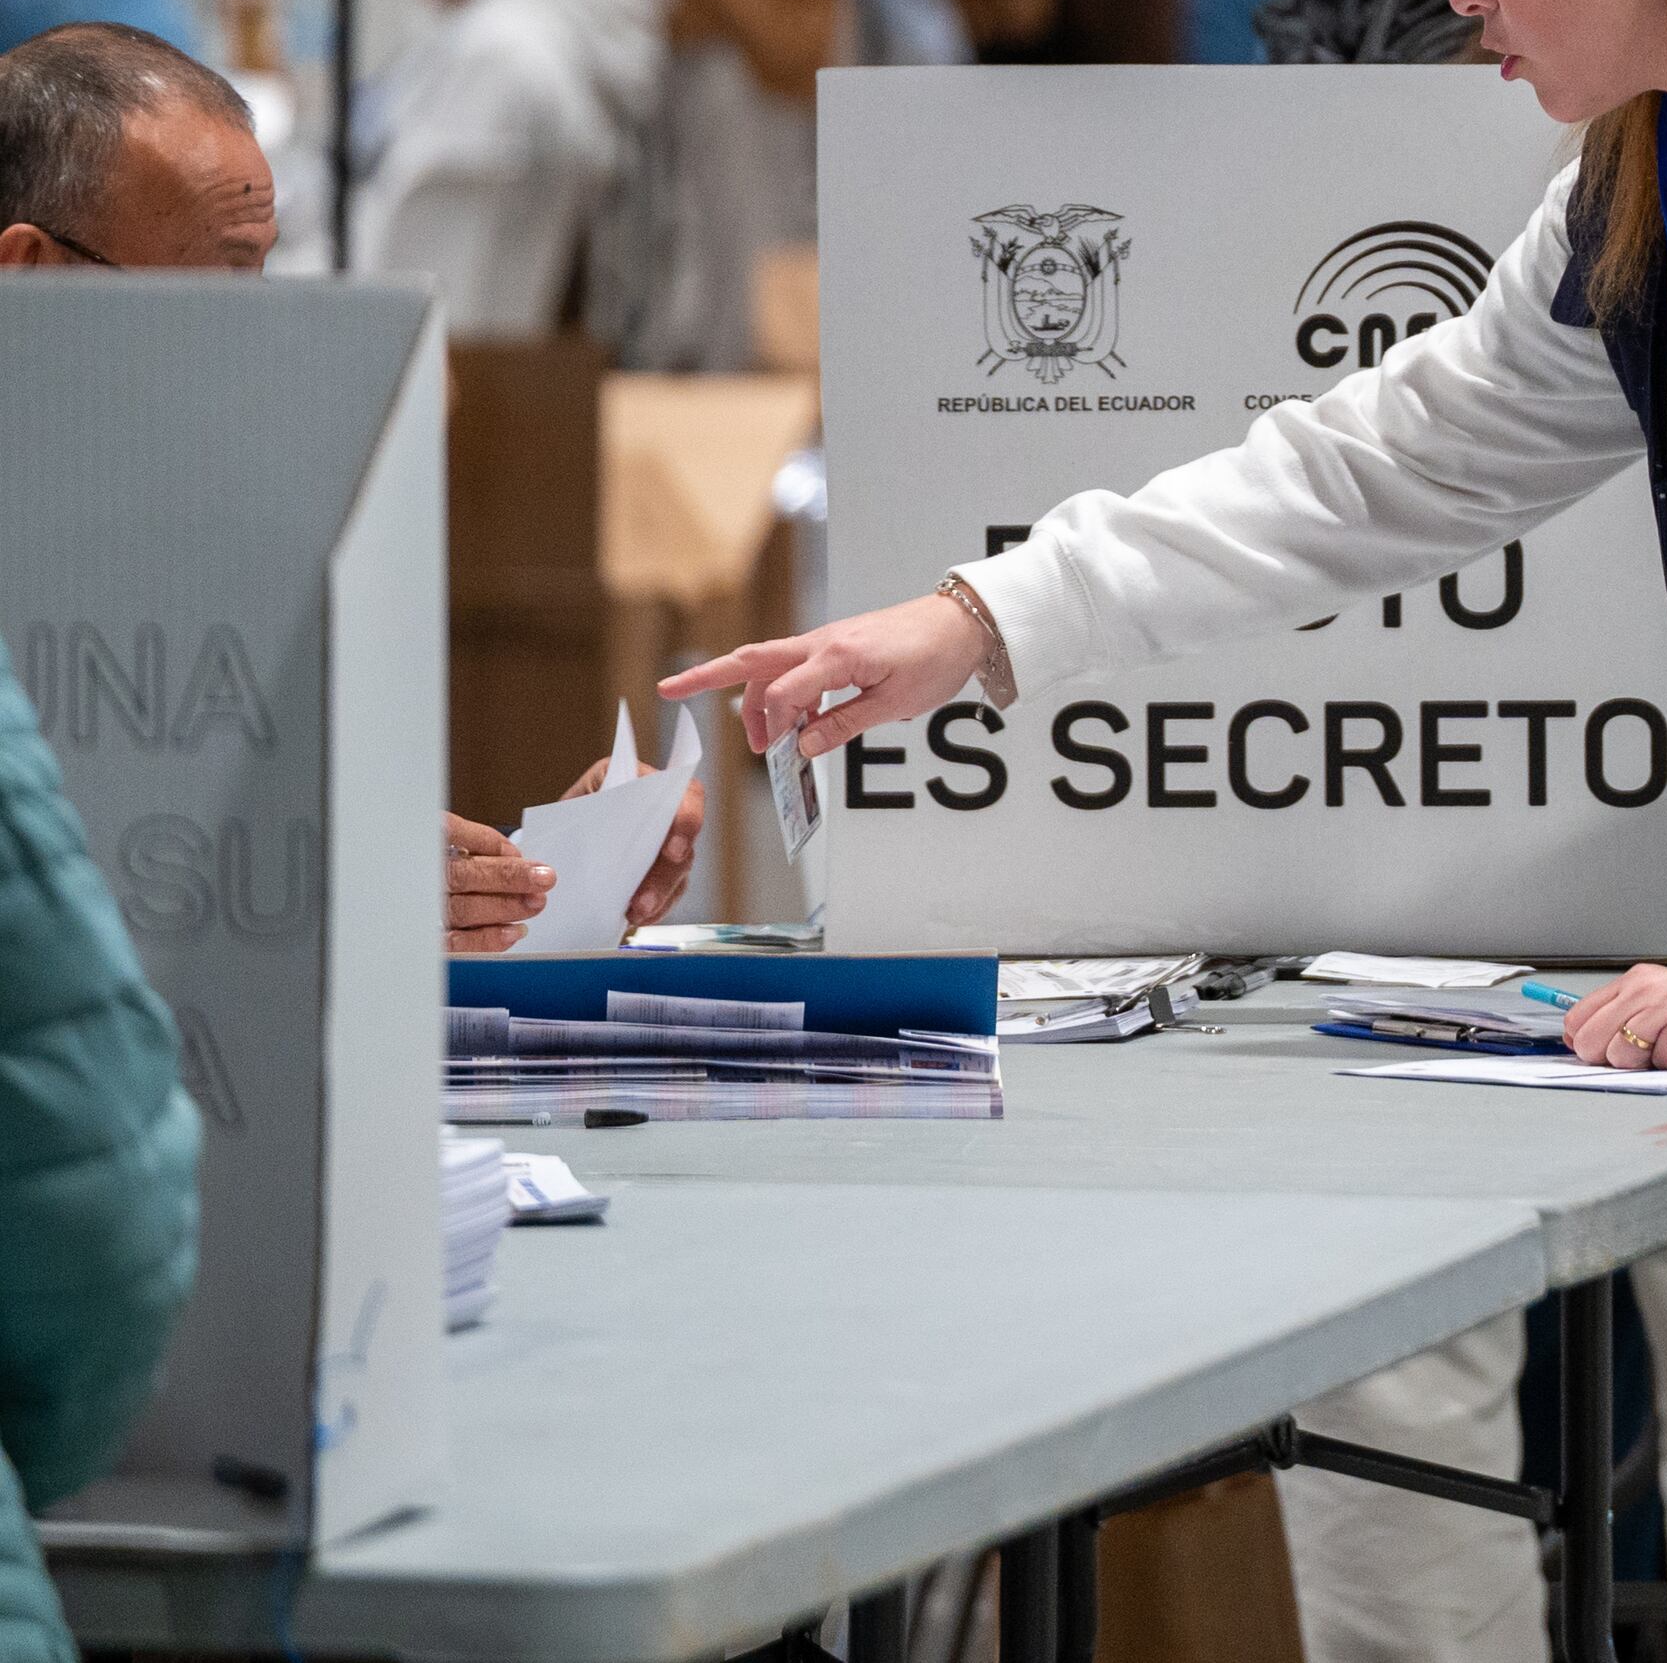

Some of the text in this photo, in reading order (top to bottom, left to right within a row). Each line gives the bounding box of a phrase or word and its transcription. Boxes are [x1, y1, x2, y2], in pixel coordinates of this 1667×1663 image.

[937, 392, 1197, 413] REPÚBLICA DEL ECUADOR
[844, 700, 1009, 811] ES
